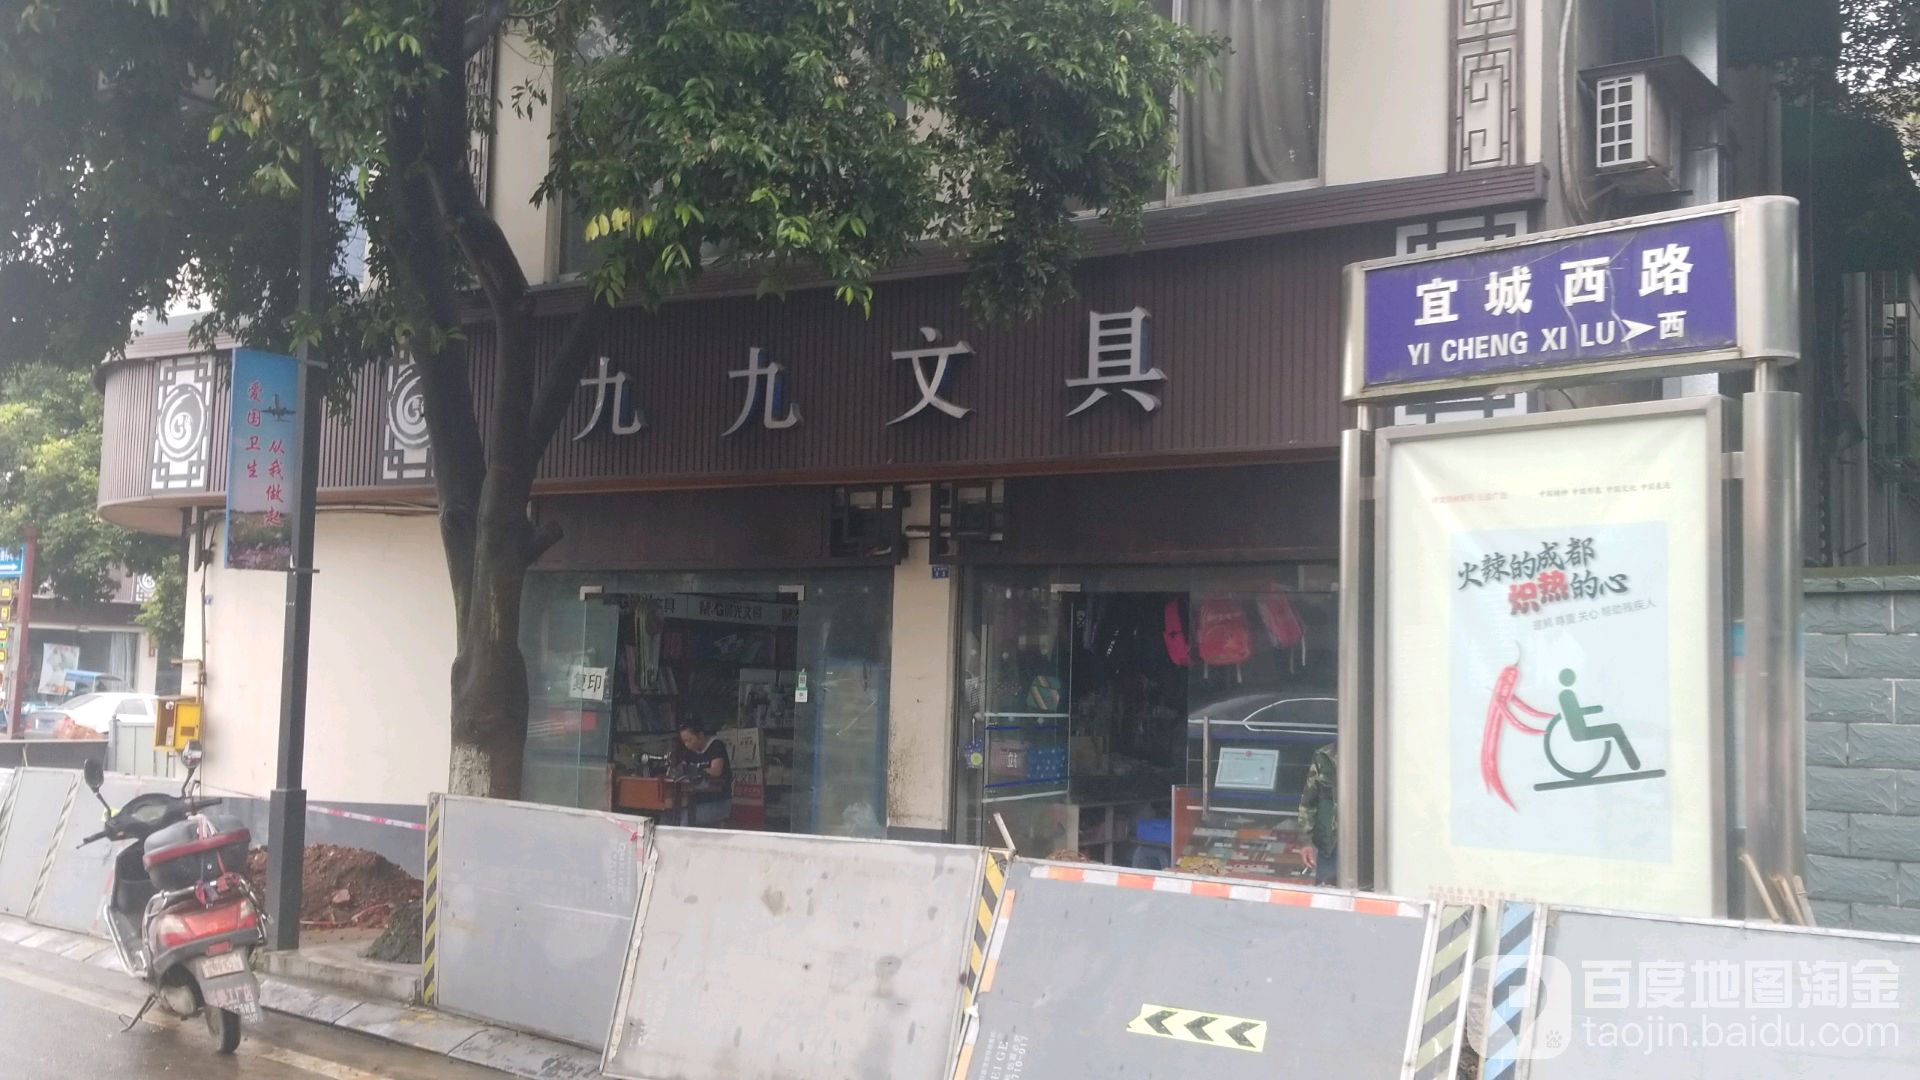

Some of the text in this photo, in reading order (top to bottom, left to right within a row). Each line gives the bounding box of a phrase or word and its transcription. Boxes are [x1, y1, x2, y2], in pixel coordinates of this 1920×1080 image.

[1413, 243, 1695, 327] 宜城西路
[1408, 320, 1616, 367] YI CHENG XI LU
[1657, 309, 1688, 341] 西
[572, 306, 1168, 442] 九九文具
[245, 381, 263, 479] 爱国卫生
[265, 439, 285, 527] 从我做起
[1457, 536, 1597, 591] 火辣的成都
[1508, 568, 1630, 616] 炽热的心
[572, 671, 602, 693] 复印
